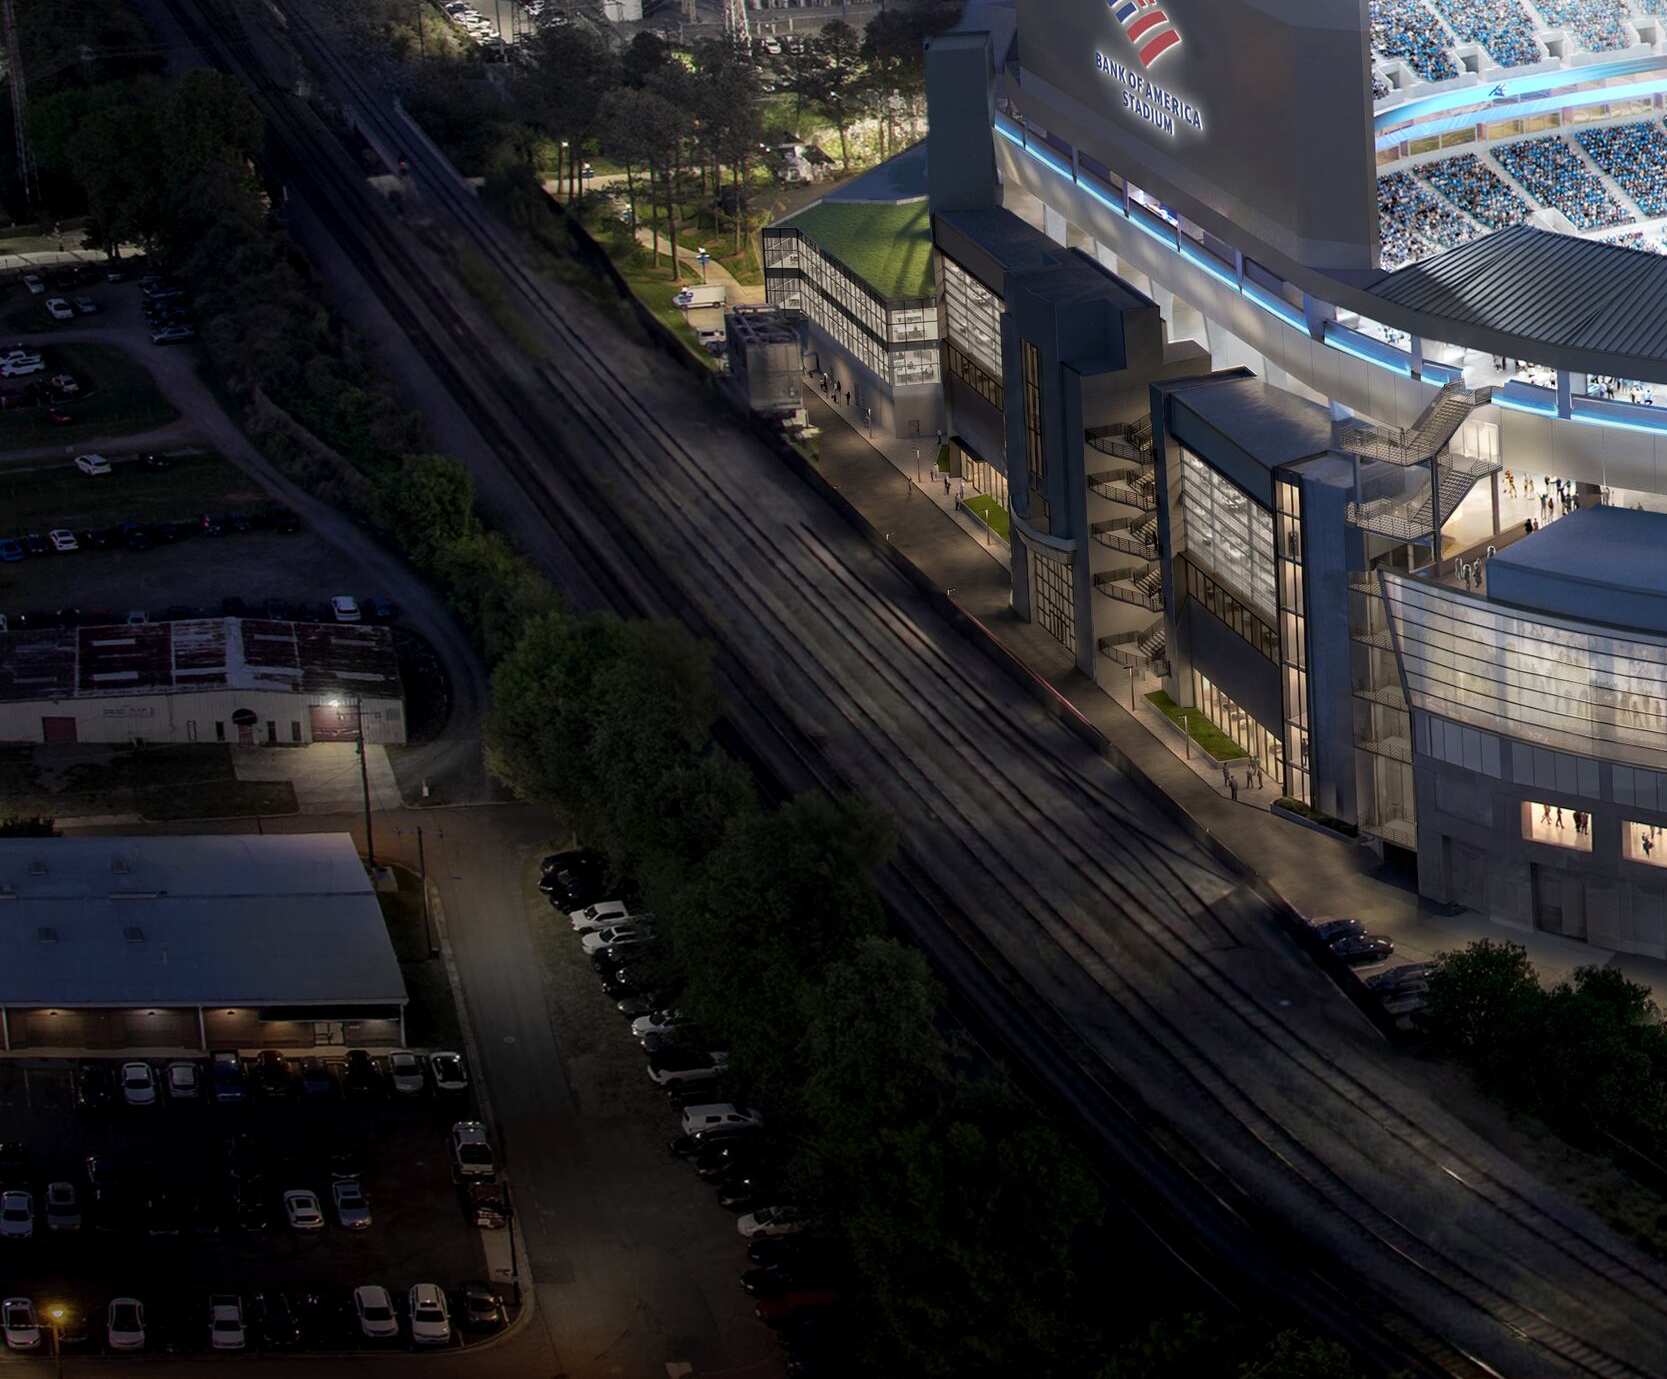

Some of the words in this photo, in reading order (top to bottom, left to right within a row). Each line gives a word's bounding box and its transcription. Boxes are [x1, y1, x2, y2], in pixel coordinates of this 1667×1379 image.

[1095, 51, 1127, 84] BANK
[1128, 72, 1145, 93] OF
[1145, 81, 1203, 131] AMERICA
[1122, 90, 1175, 136] STADIUM
